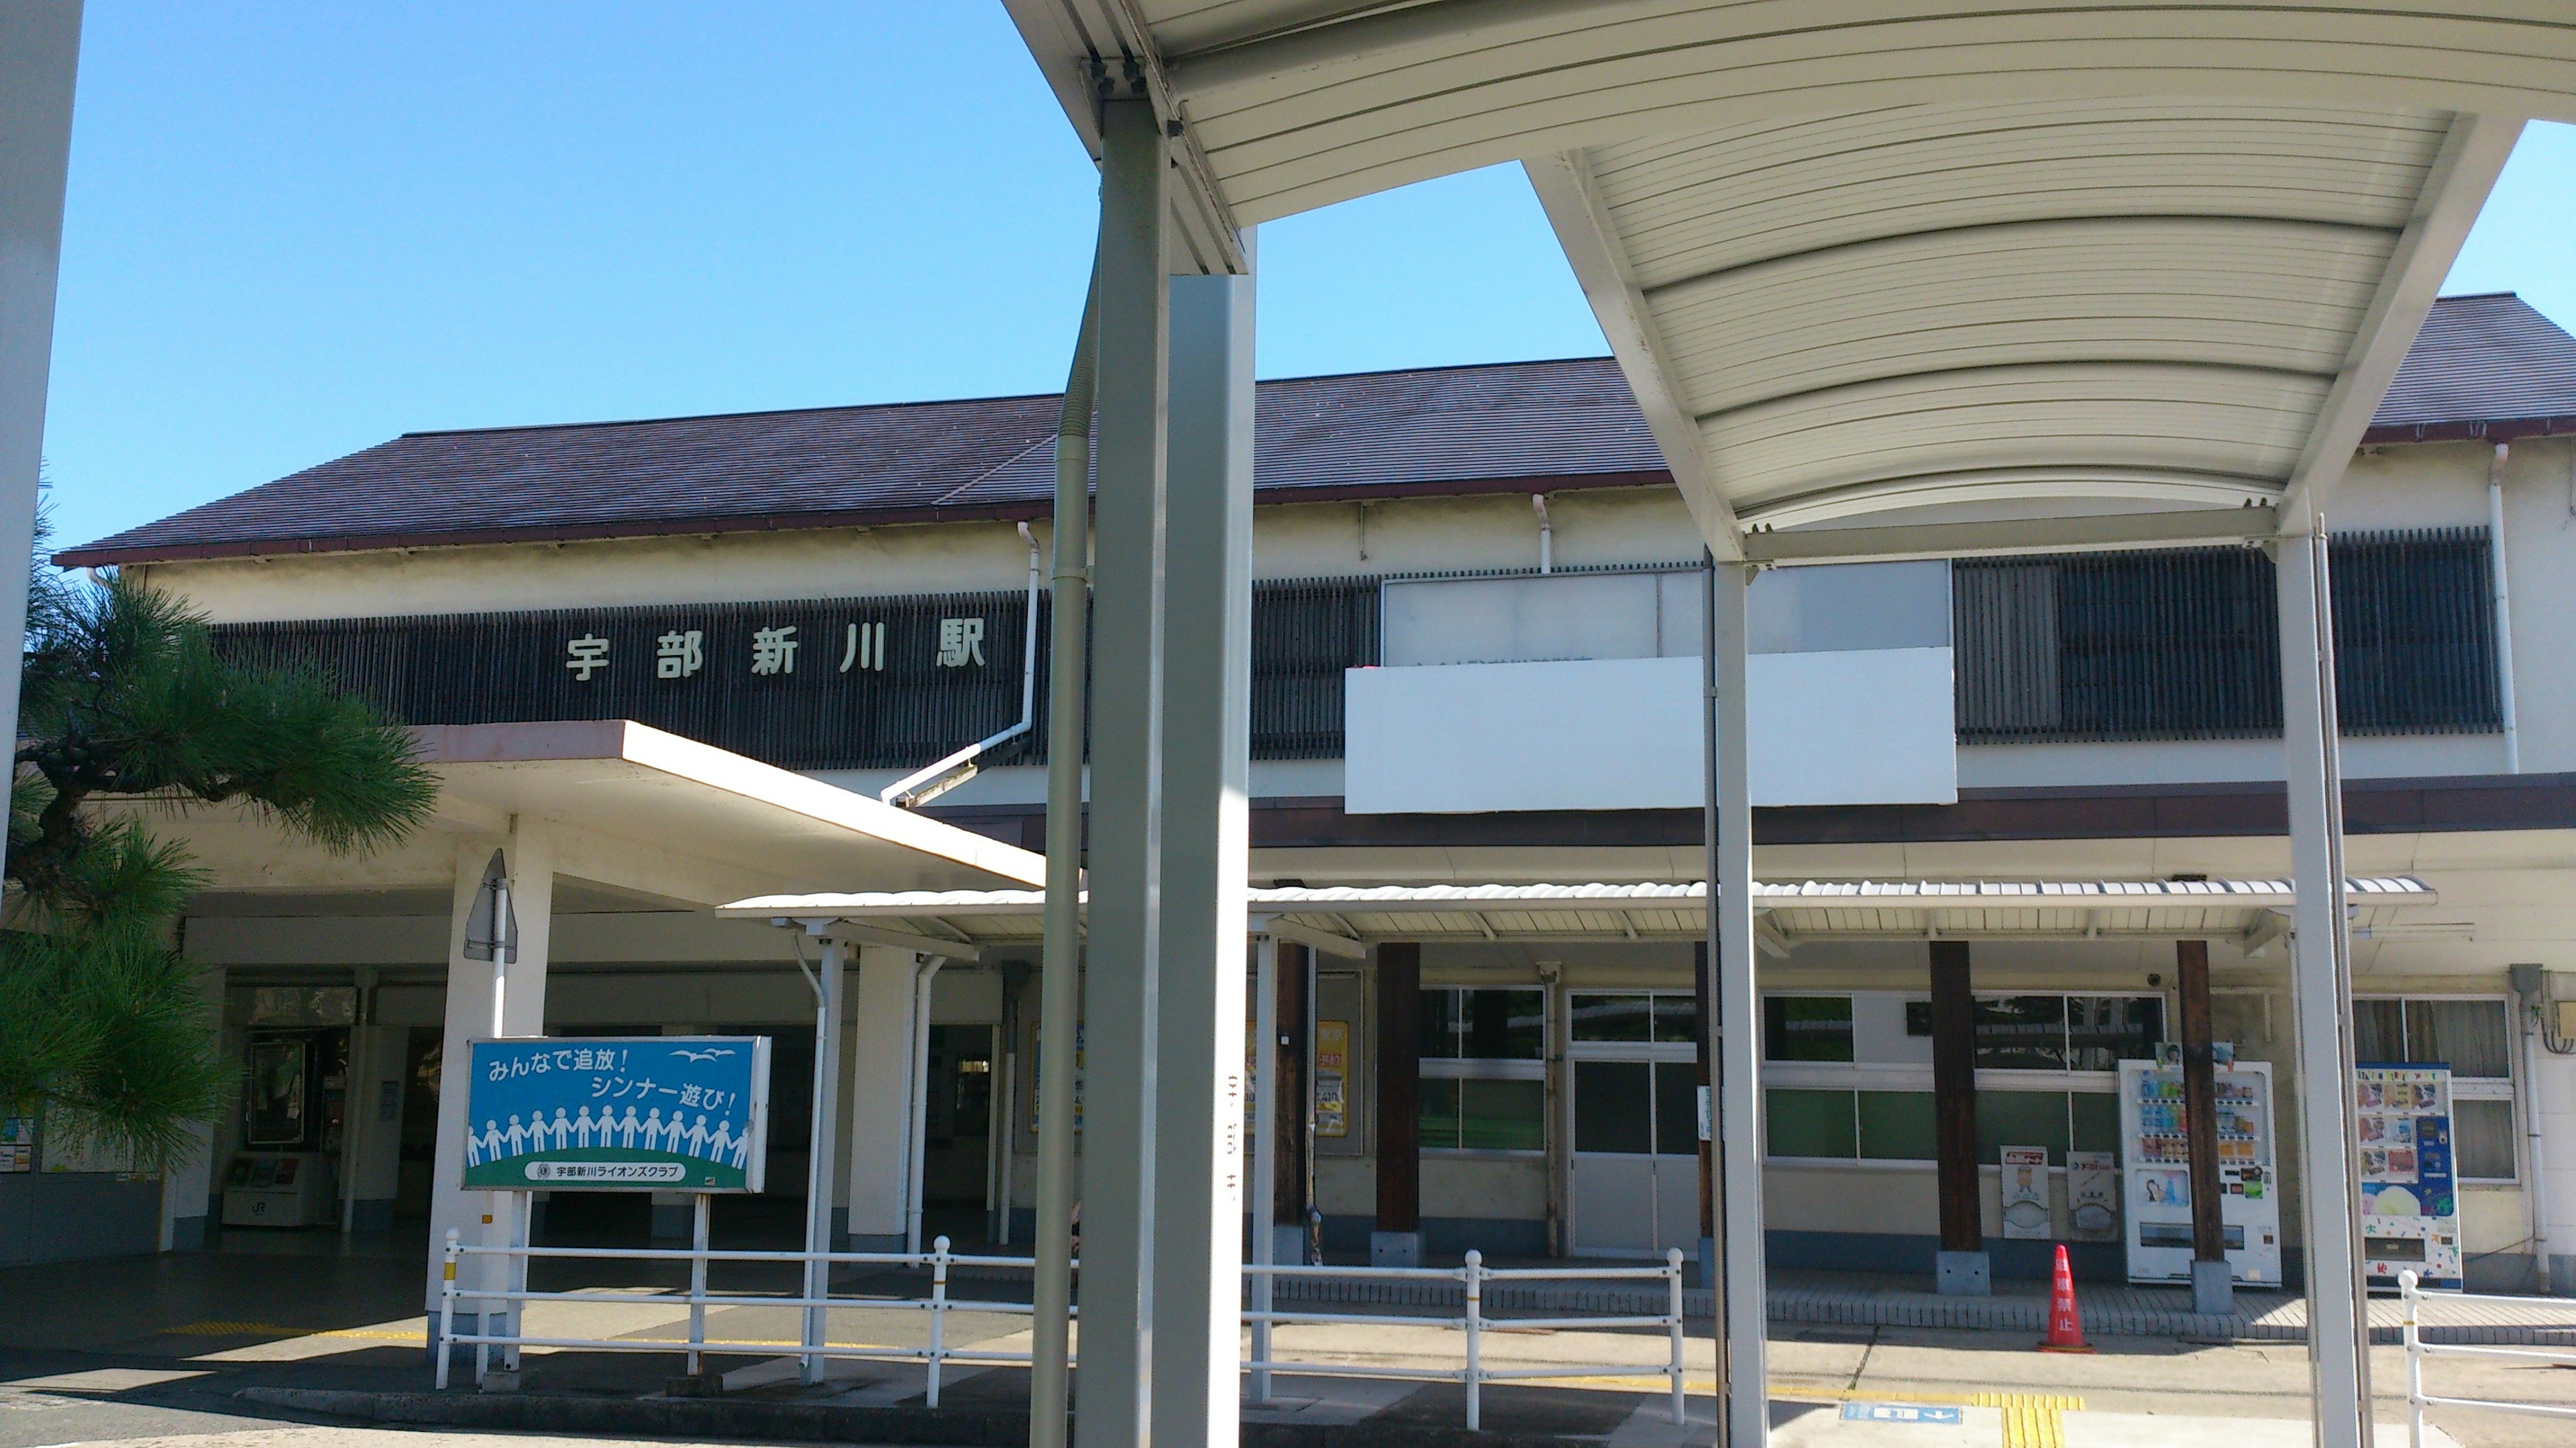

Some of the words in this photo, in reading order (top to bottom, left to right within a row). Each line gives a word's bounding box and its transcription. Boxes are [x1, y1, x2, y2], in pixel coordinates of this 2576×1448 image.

[566, 618, 985, 681] 宇部新川駅
[488, 1048, 629, 1081] みんなで追放!
[592, 1076, 737, 1117] シンナー遊び!
[556, 1166, 679, 1178] 宇部新川ライオンズクラブ
[252, 1202, 265, 1213] JR
